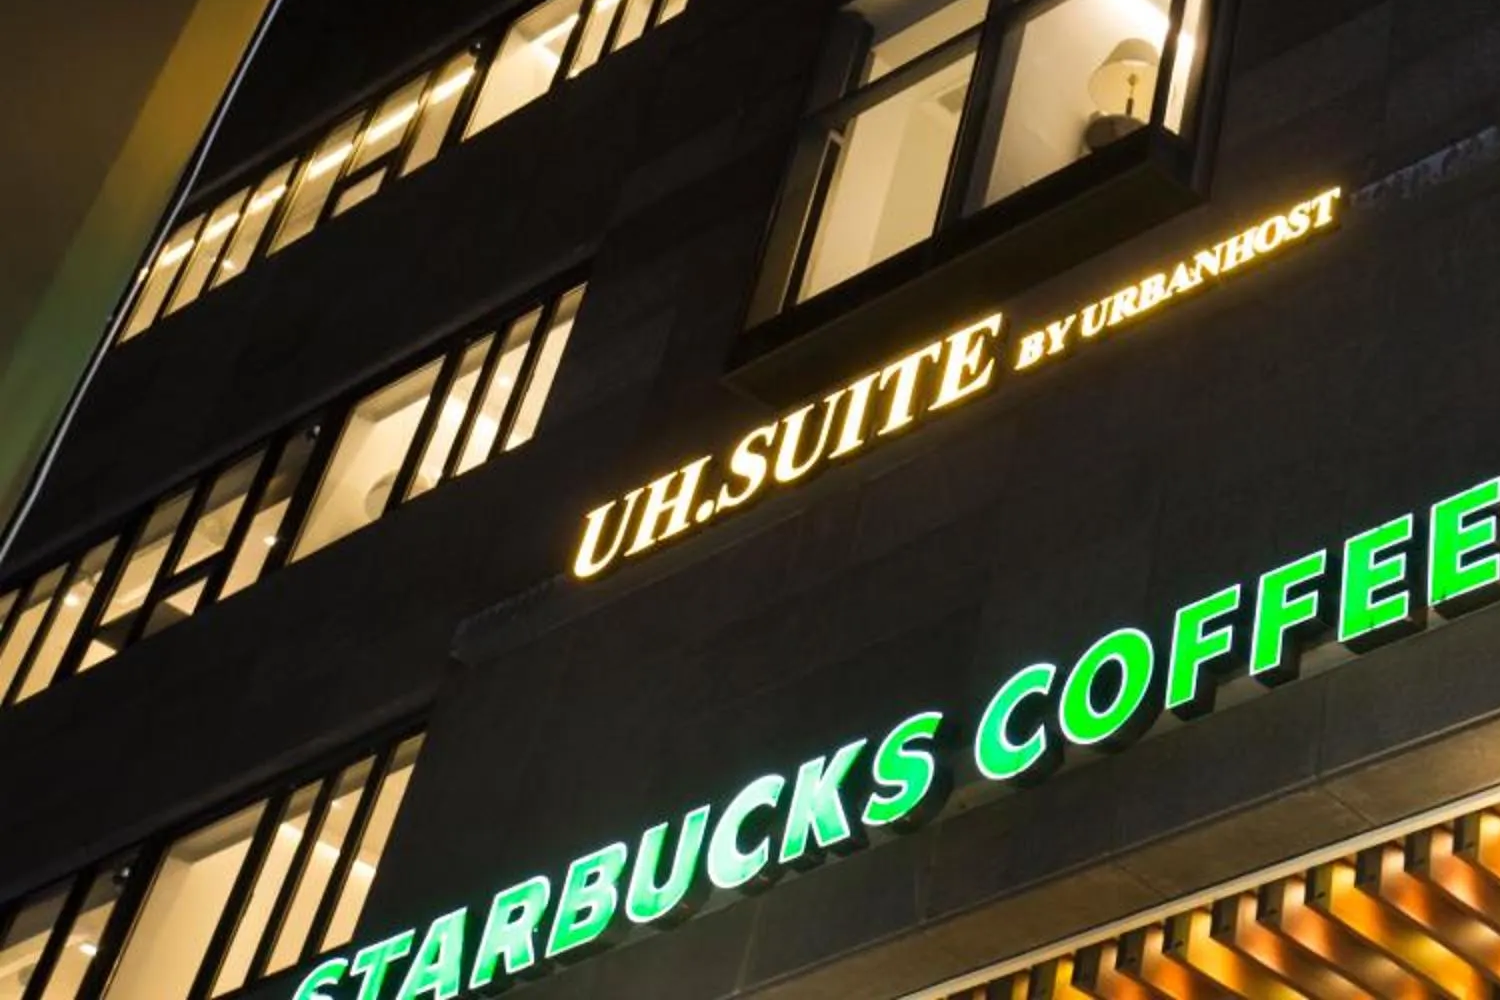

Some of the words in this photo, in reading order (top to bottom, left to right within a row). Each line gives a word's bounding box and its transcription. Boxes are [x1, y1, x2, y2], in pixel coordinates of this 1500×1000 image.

[572, 312, 1002, 579] UH.SUITE
[1014, 313, 1077, 371] BY
[1079, 187, 1341, 337] URBANHOST
